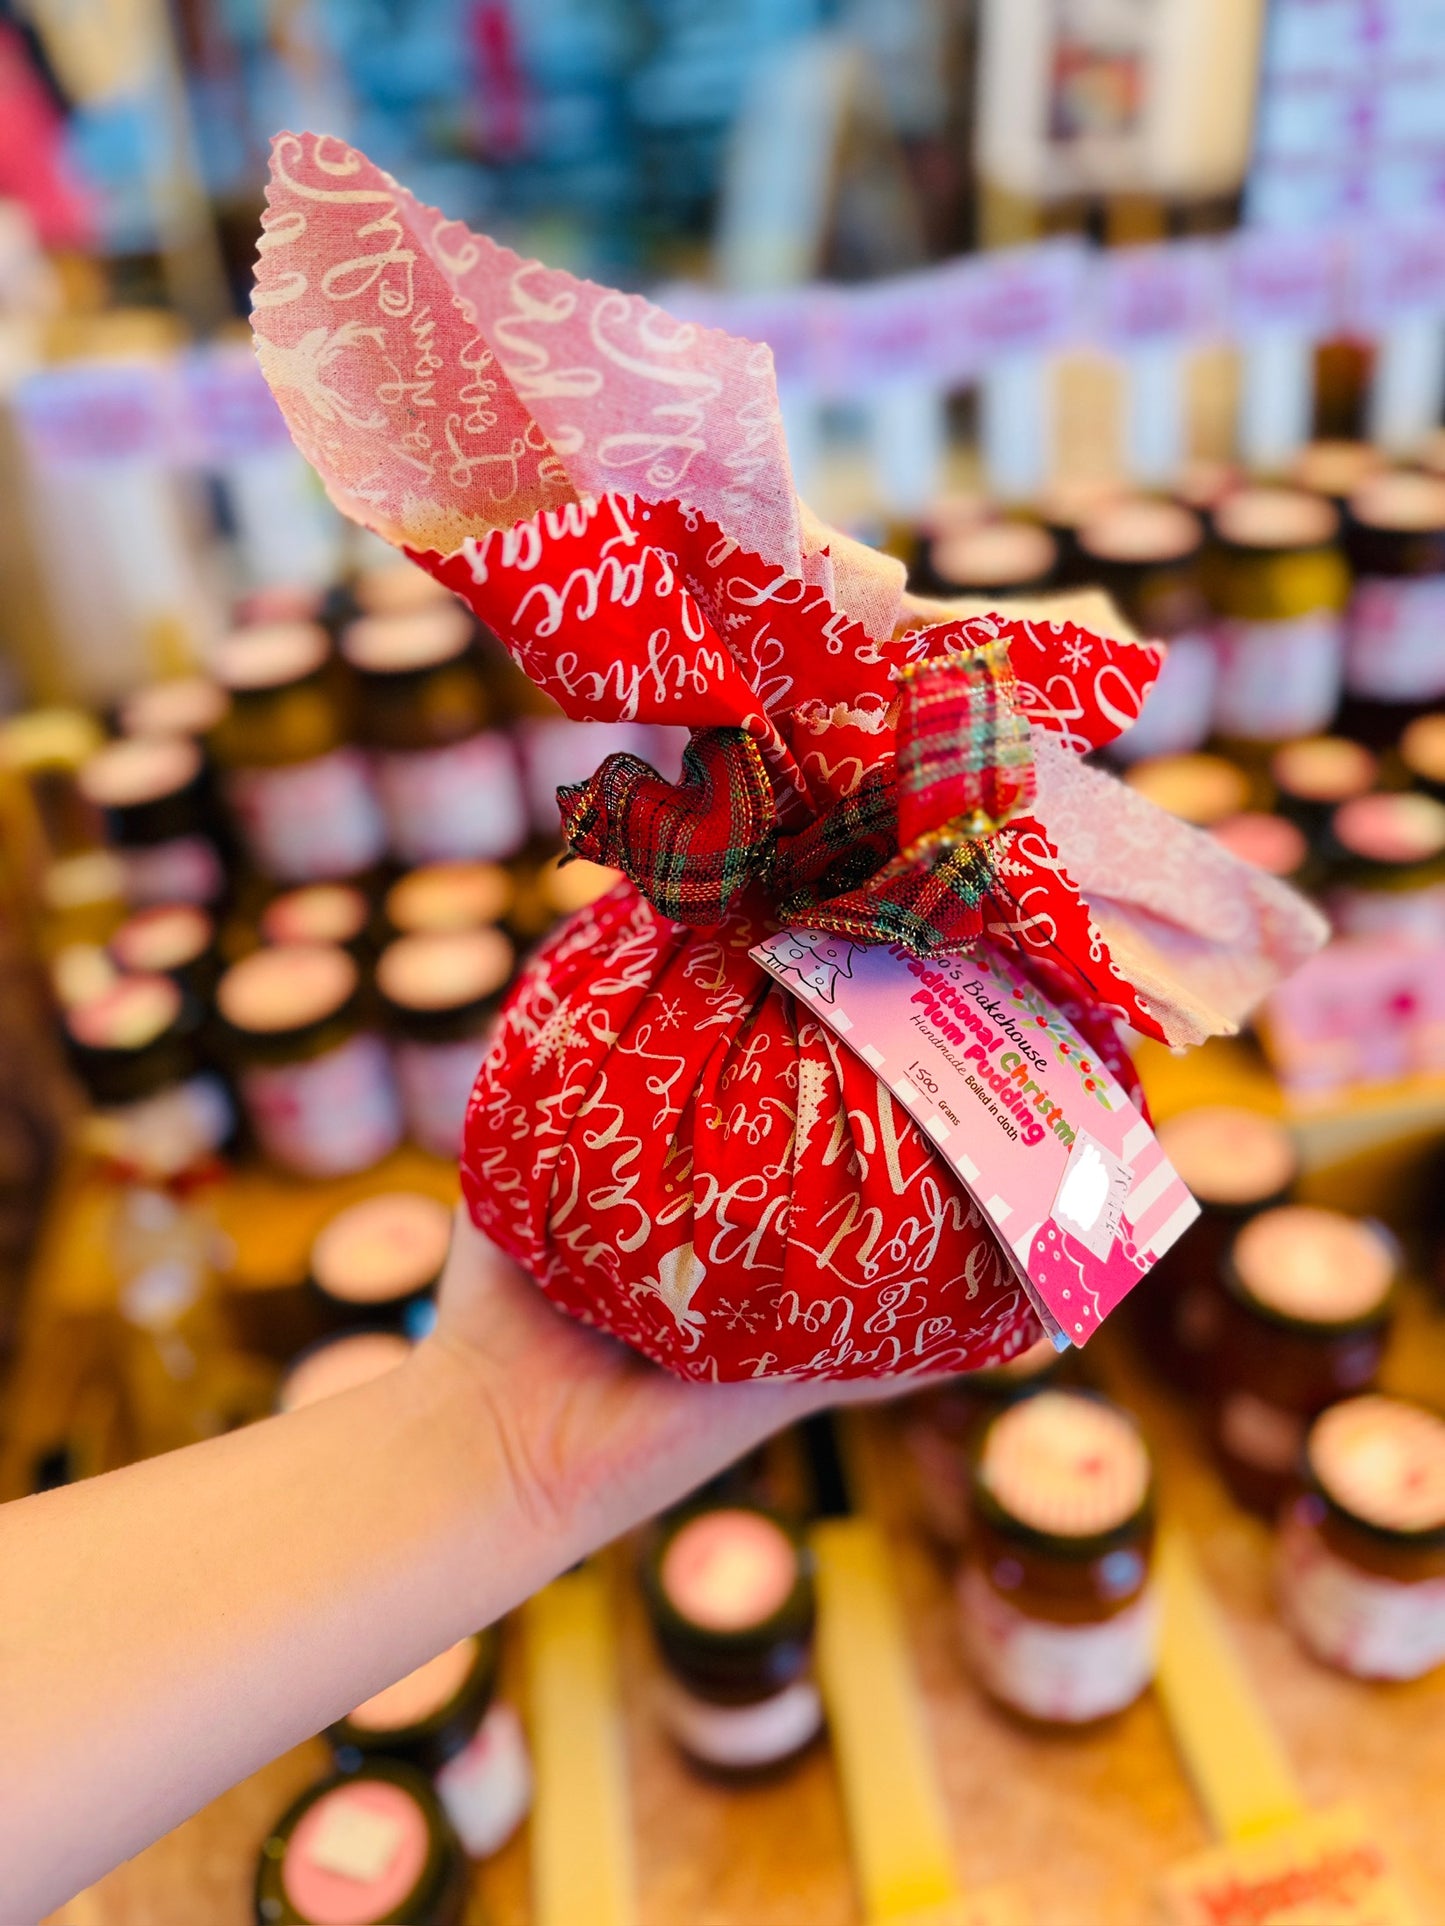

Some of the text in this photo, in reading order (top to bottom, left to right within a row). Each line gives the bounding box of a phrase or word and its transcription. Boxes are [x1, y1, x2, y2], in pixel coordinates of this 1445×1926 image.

[549, 628, 726, 720] wishes
[911, 989, 1046, 1147] Plum Pudding
[962, 979, 1048, 1073] Bakehouse
[909, 1014, 1018, 1141] Handmade Boiled in cloth
[938, 1100, 961, 1126] Grams
[1000, 1051, 1075, 1153] Christm
